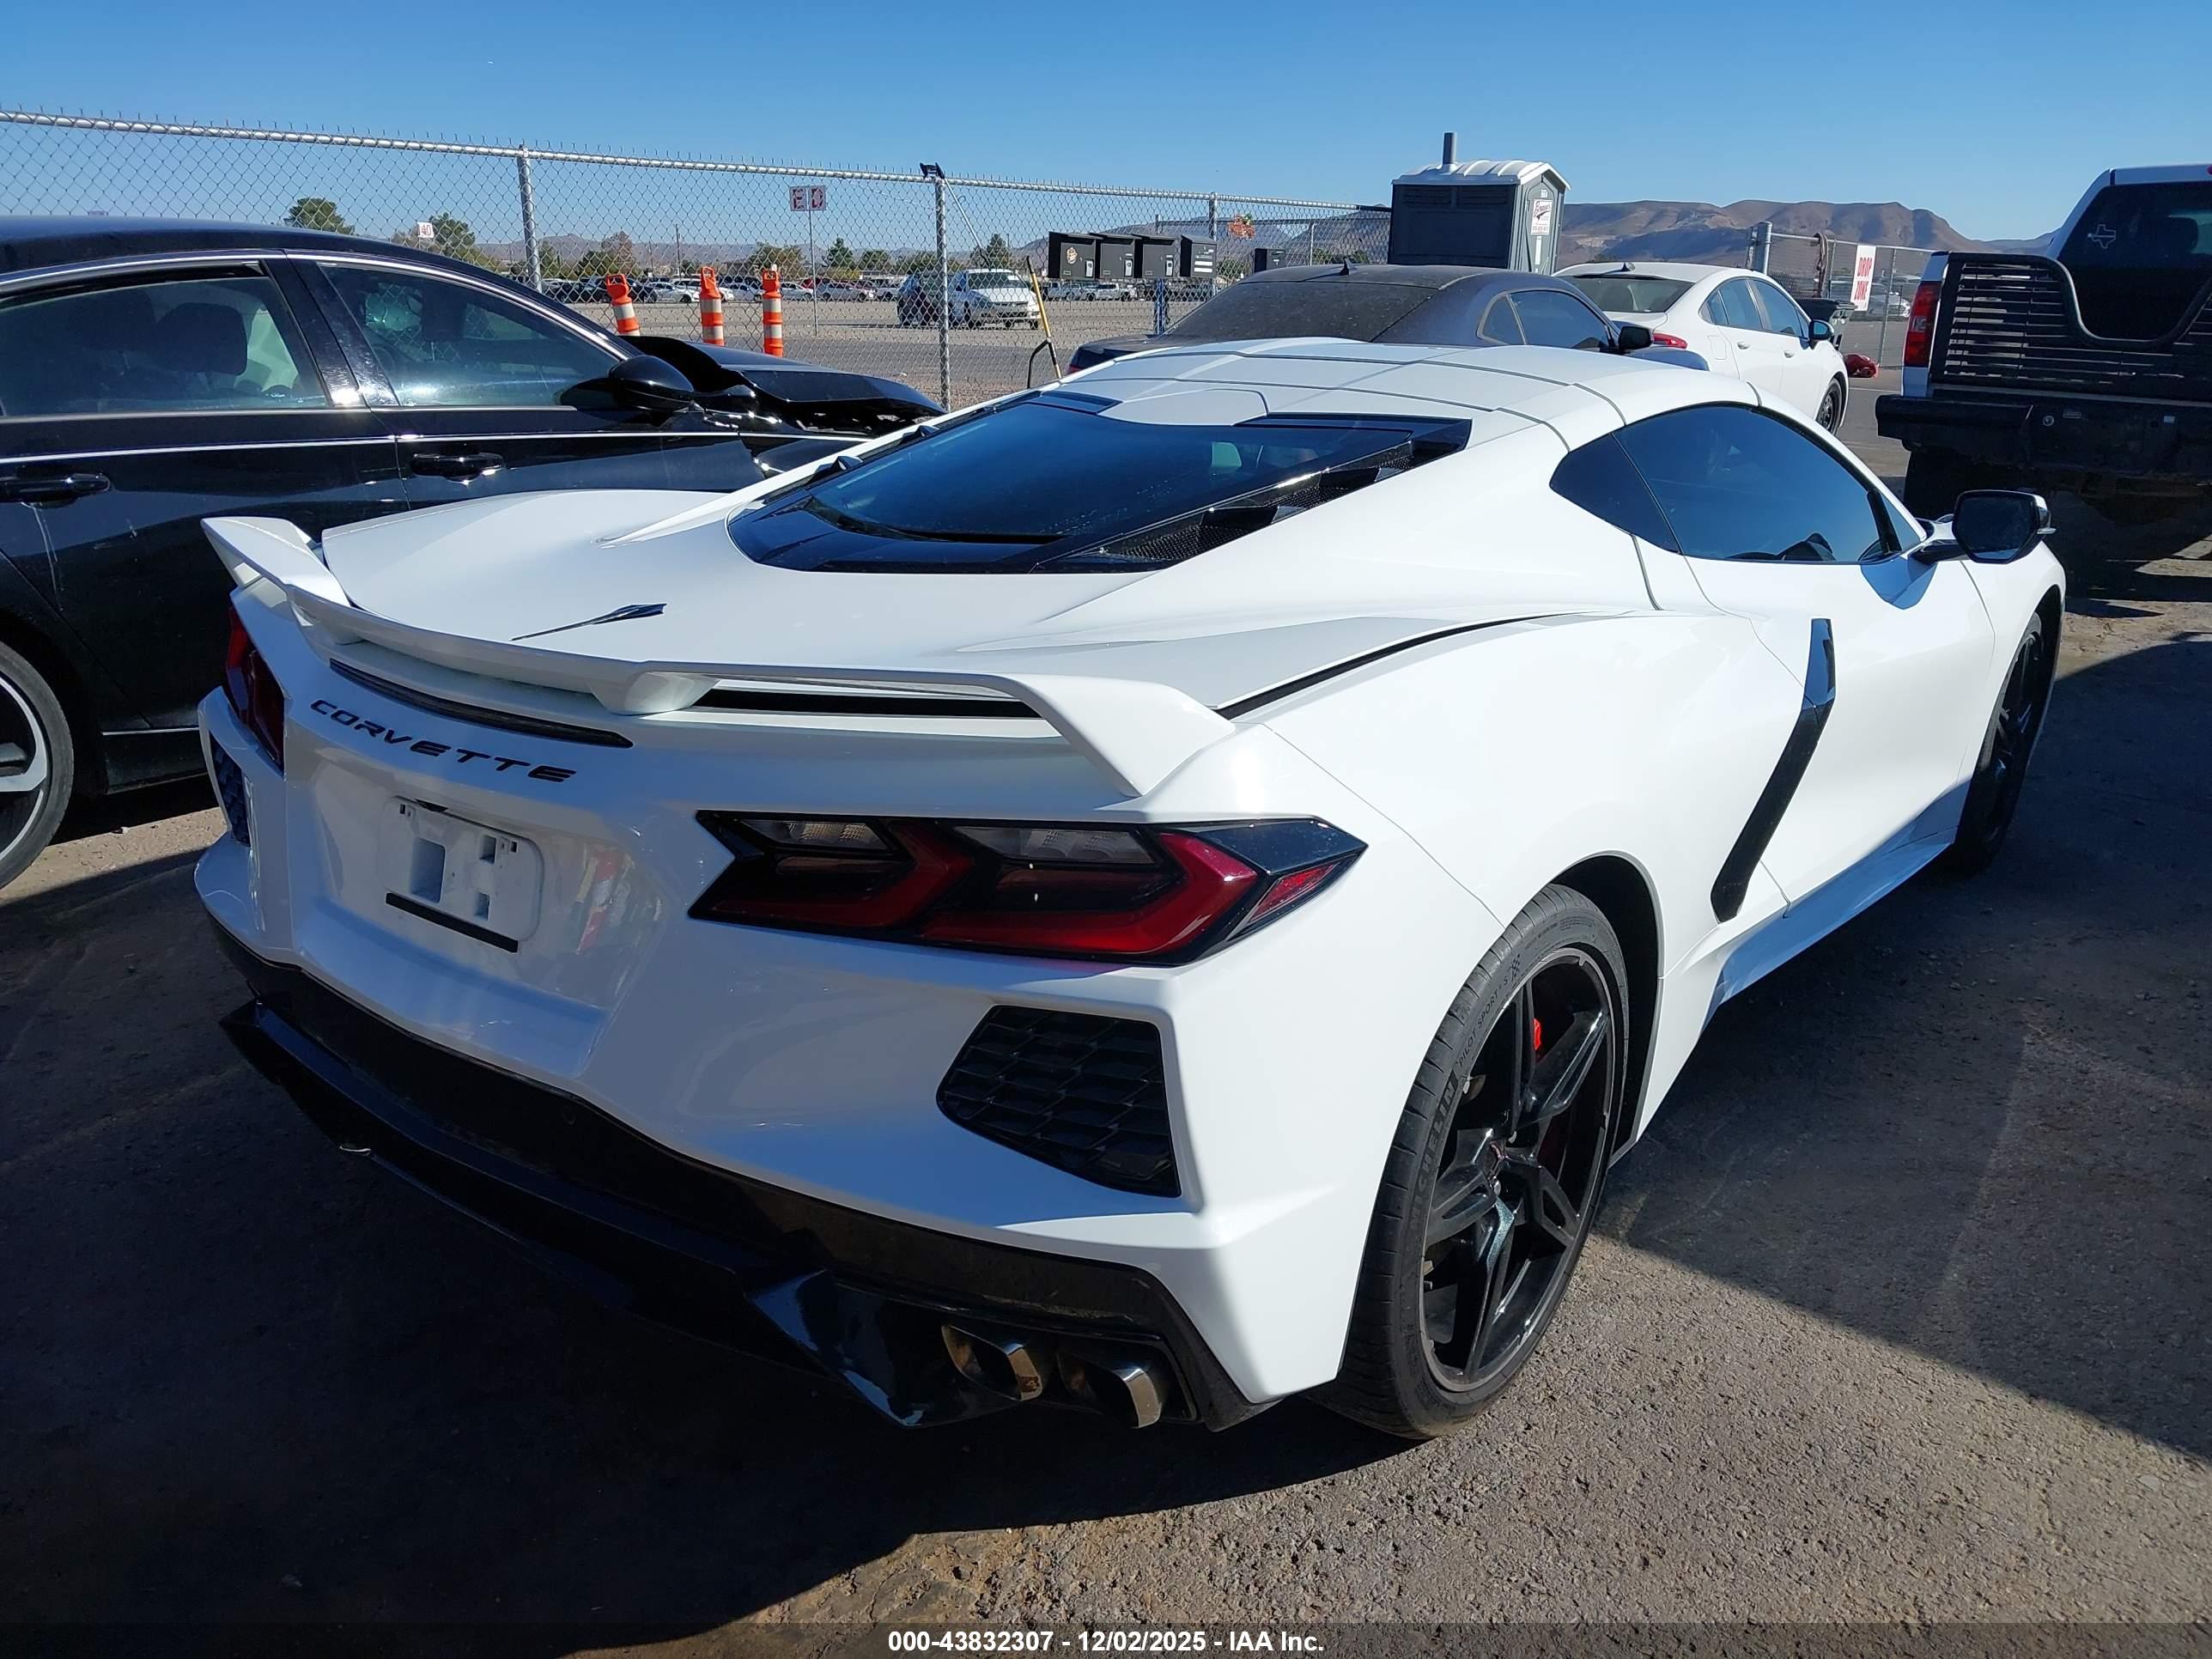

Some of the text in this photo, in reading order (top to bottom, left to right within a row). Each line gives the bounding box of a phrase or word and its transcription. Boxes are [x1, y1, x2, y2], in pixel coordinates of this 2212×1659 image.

[1857, 257, 1873, 276] DROP
[310, 699, 577, 783] CORVETTE
[1409, 1082, 1456, 1231] MICHELIN
[1457, 1029, 1476, 1066] PILOT
[1478, 989, 1498, 1028] SPORT
